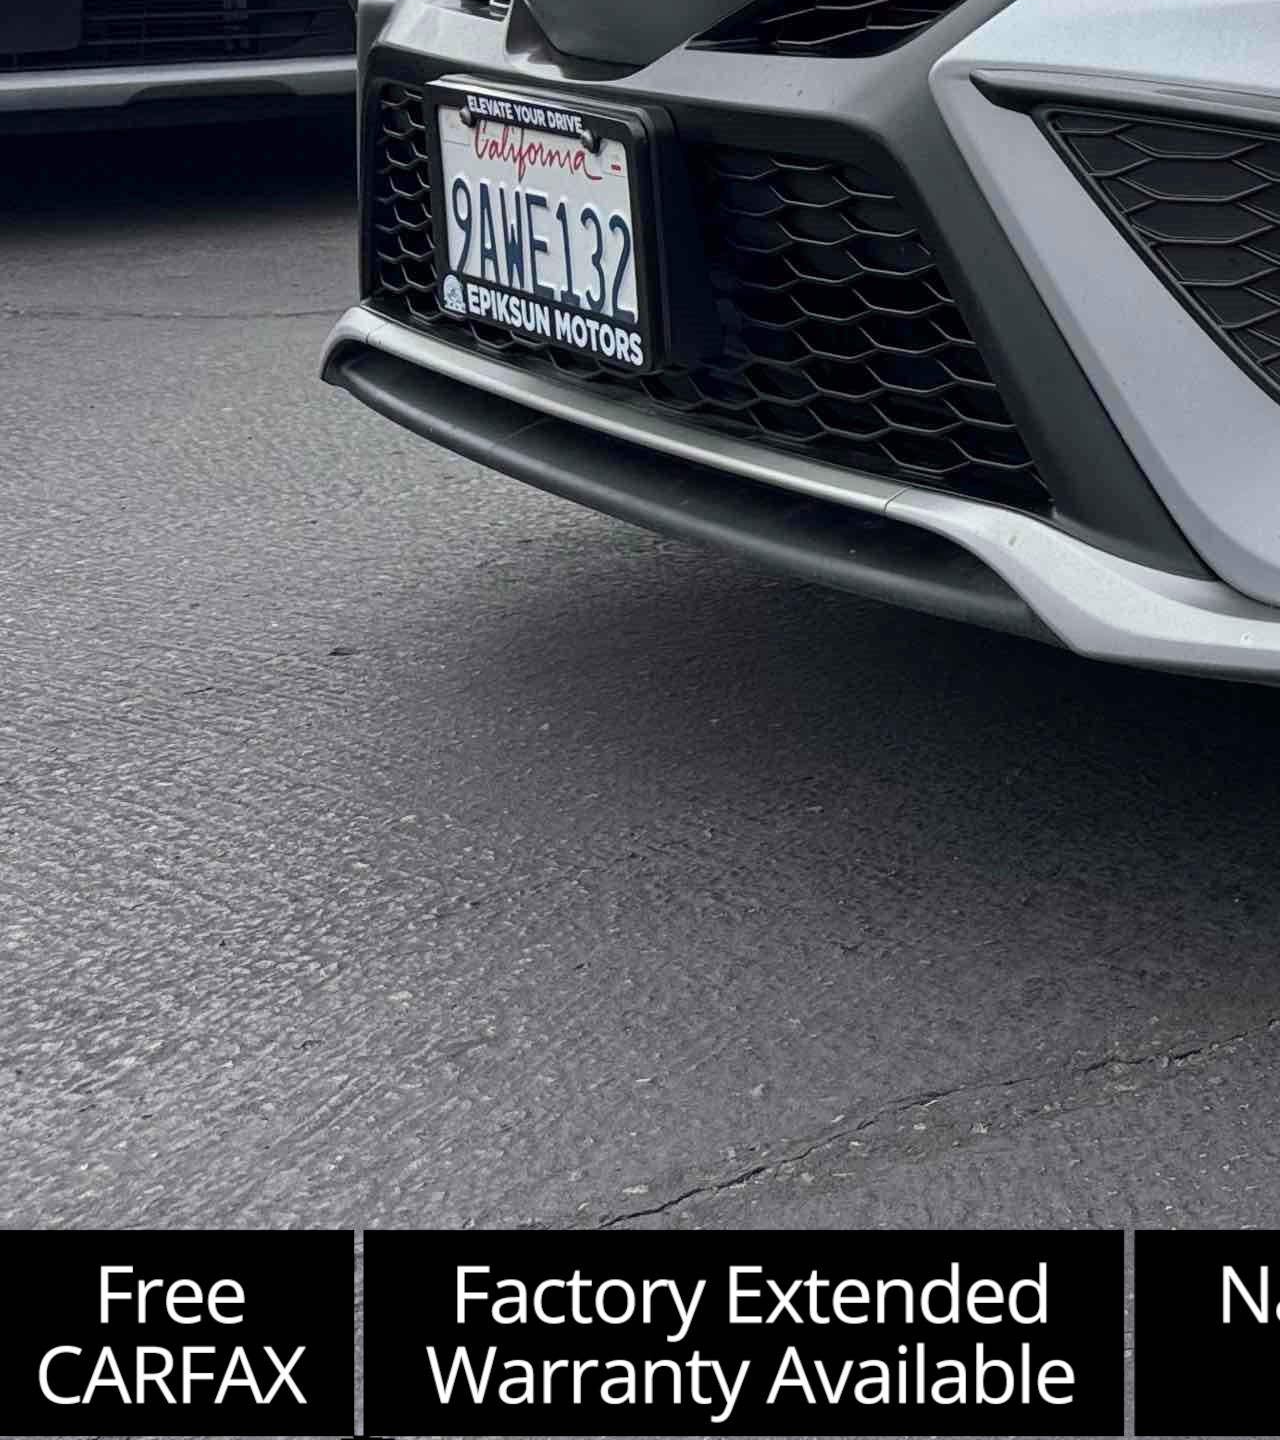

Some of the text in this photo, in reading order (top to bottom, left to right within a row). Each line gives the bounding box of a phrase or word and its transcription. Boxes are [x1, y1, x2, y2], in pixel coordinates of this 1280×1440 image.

[466, 95, 584, 134] ELEVATE YOUR DRIVE
[472, 124, 602, 183] California
[451, 176, 639, 324] 9AWE132
[466, 283, 644, 367] EPIKSUN MOTORS
